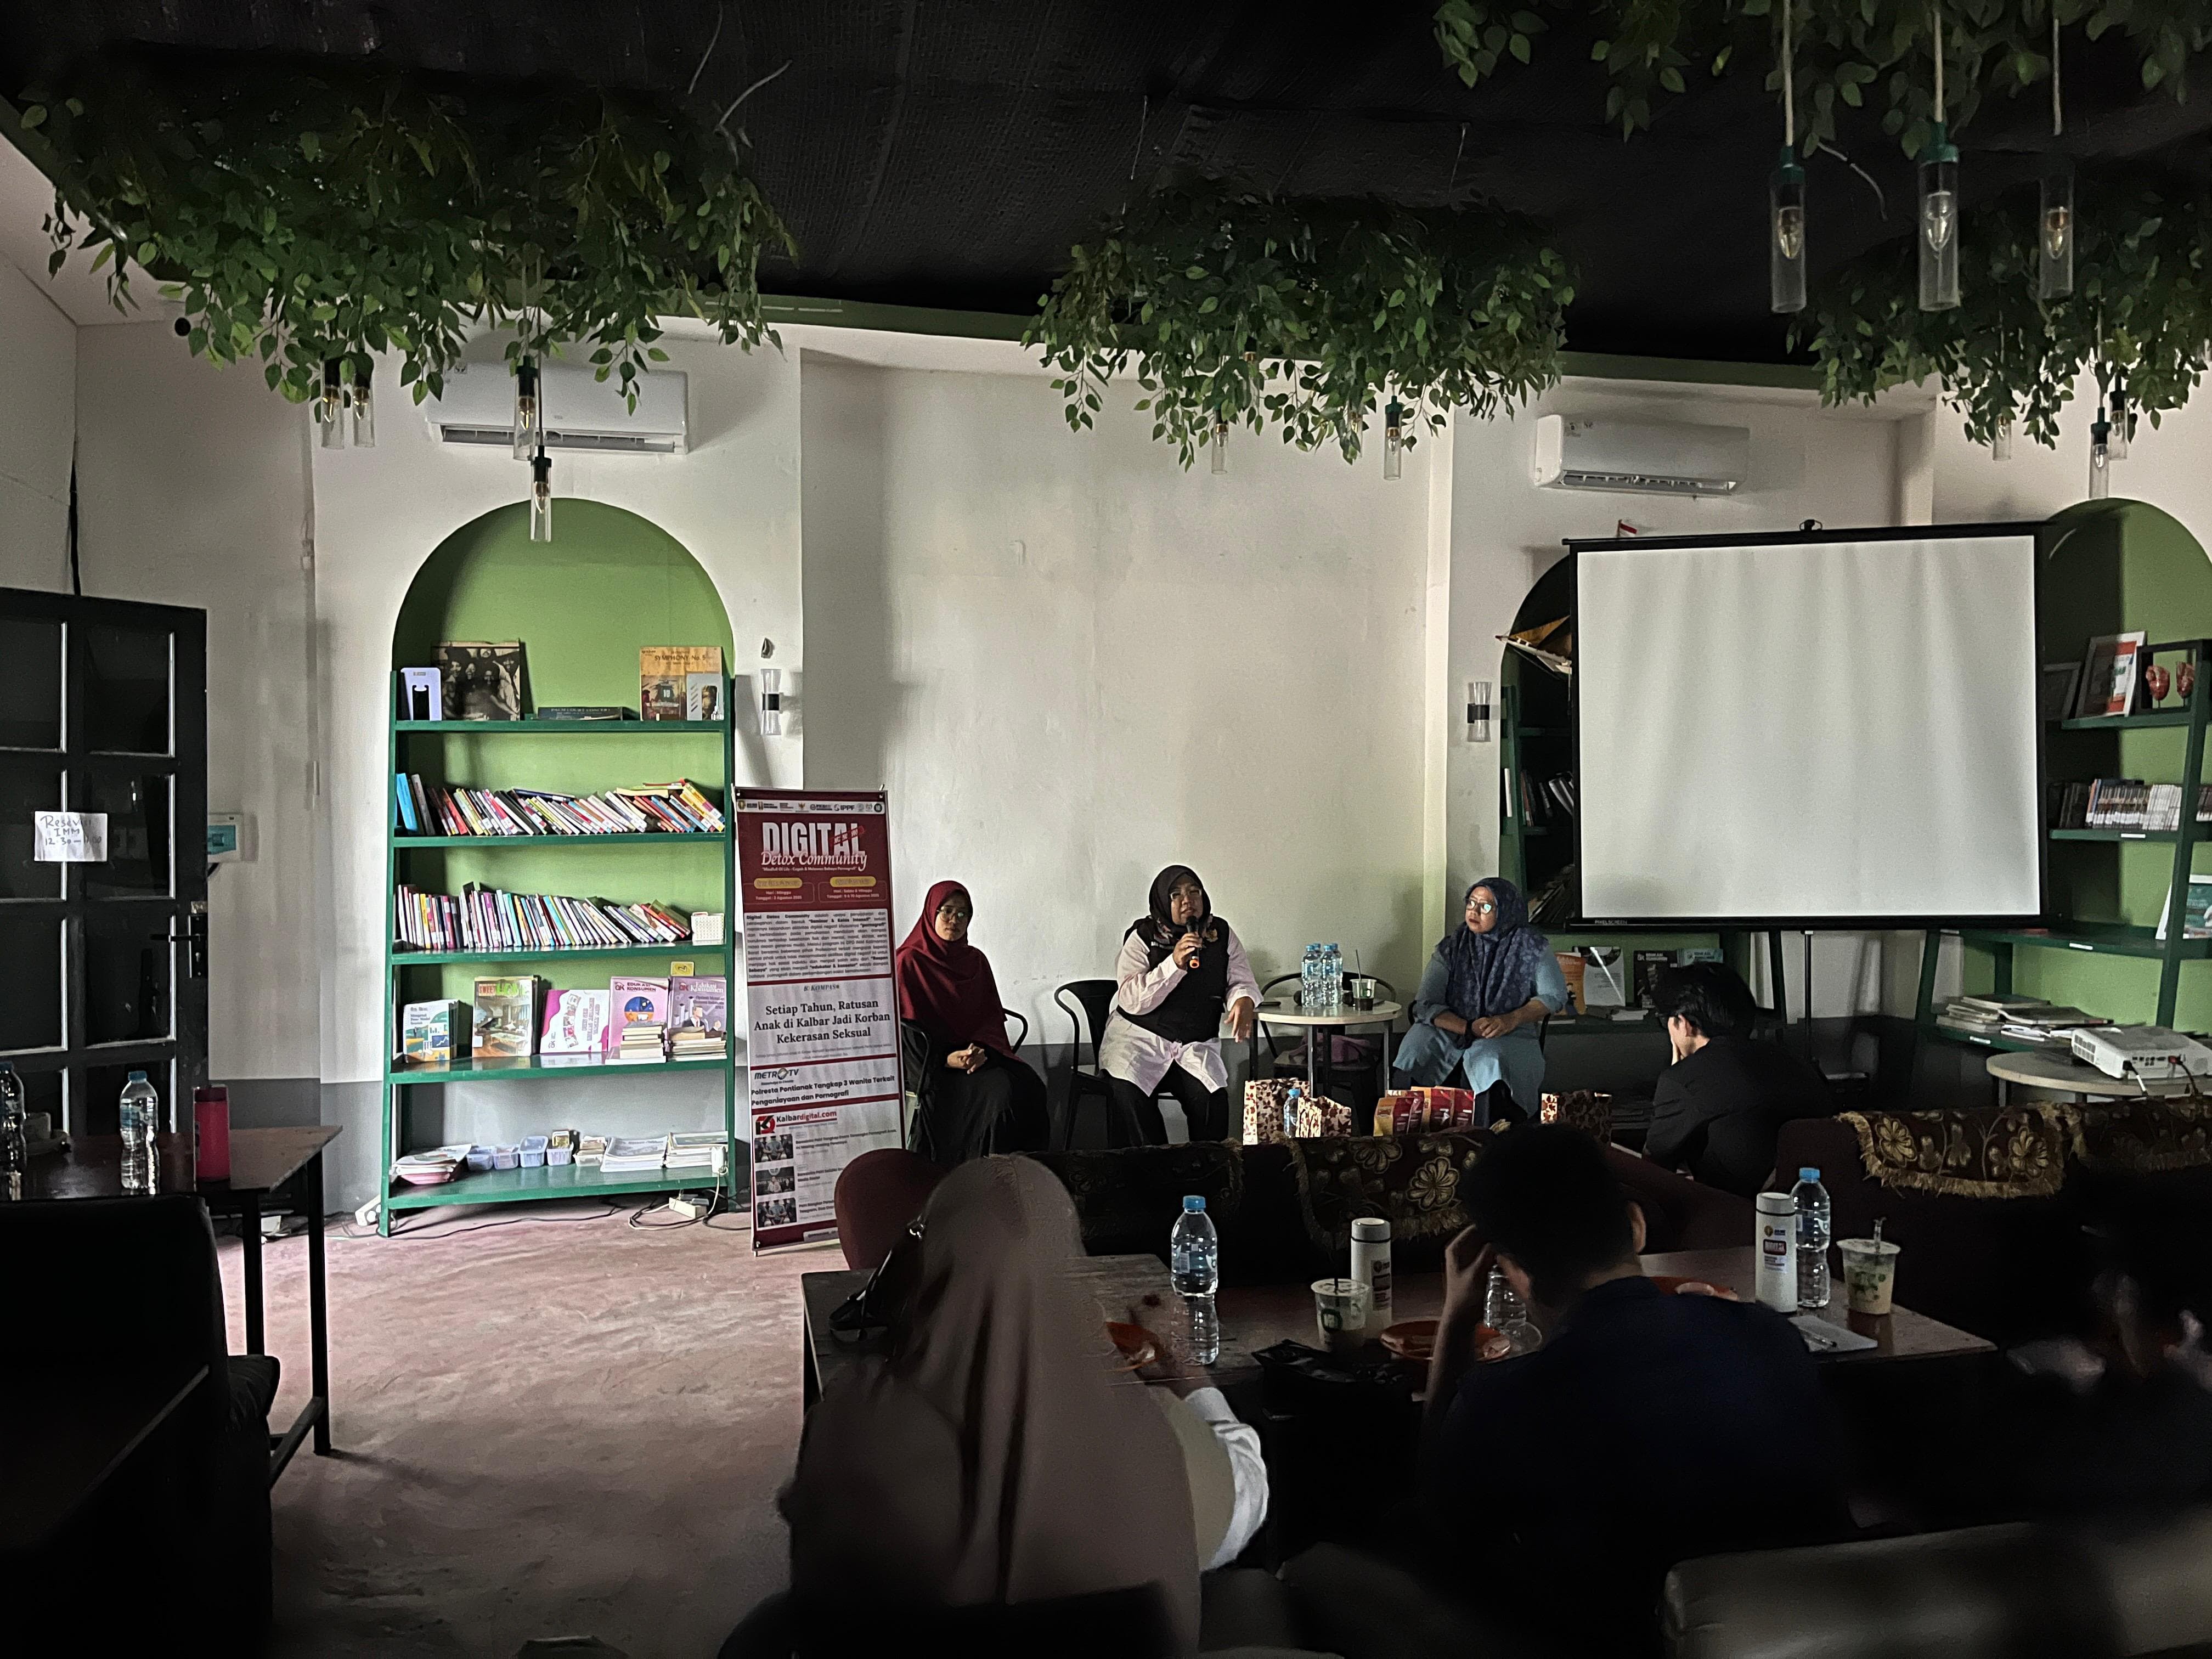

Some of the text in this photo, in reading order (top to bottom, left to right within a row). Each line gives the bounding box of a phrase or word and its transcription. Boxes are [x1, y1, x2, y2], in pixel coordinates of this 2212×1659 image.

[54, 828, 80, 837] IMM
[761, 822, 865, 857] DIGITAL
[761, 851, 867, 871] Detox Community
[765, 1000, 878, 1015] Setiap Tahun, Ratusan
[754, 1013, 890, 1031] Anak di Kalbar Jadi Korban
[777, 1027, 871, 1043] Kekerasan Seksual
[752, 1087, 778, 1095] Polresta
[780, 1084, 813, 1093] Pontianak
[815, 1081, 843, 1090] Tangkap
[752, 1096, 800, 1106] Penganiayaan
[815, 1090, 849, 1099] Pornografi
[776, 1110, 837, 1122] Kalbardigital.com
